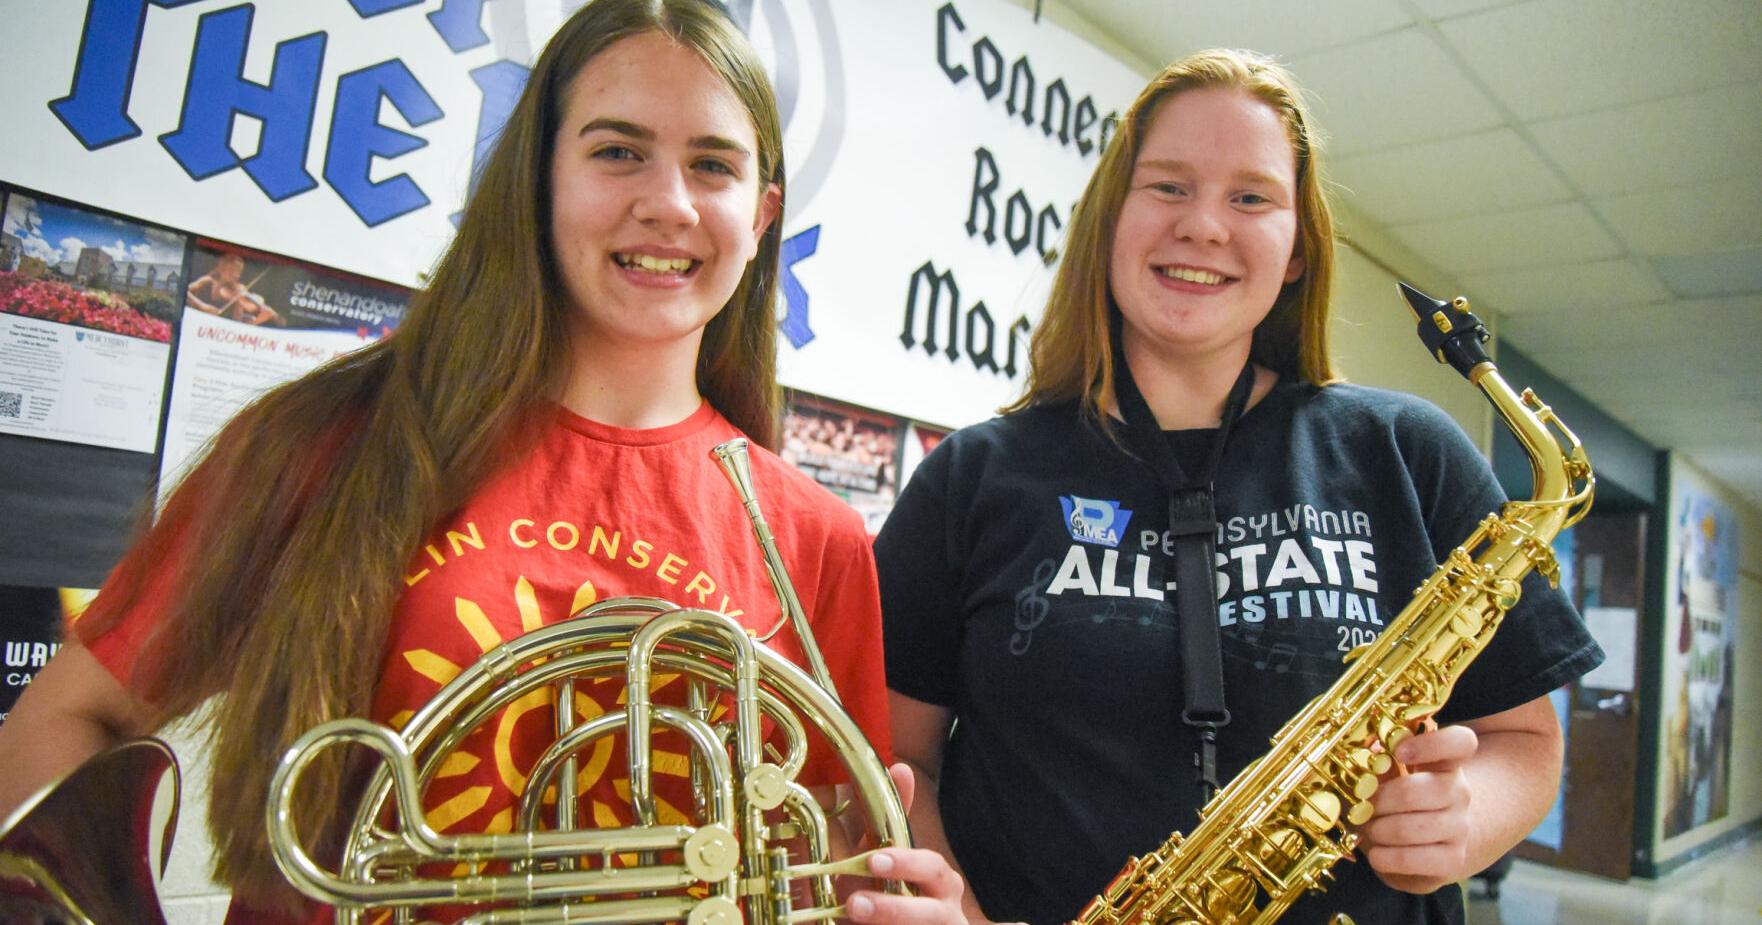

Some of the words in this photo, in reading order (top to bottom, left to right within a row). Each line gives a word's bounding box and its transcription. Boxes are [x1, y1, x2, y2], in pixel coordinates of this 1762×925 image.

[289, 296, 384, 326] conservatory
[197, 325, 279, 352] UNCOMMON
[1218, 589, 1384, 628] ESTIVAL
